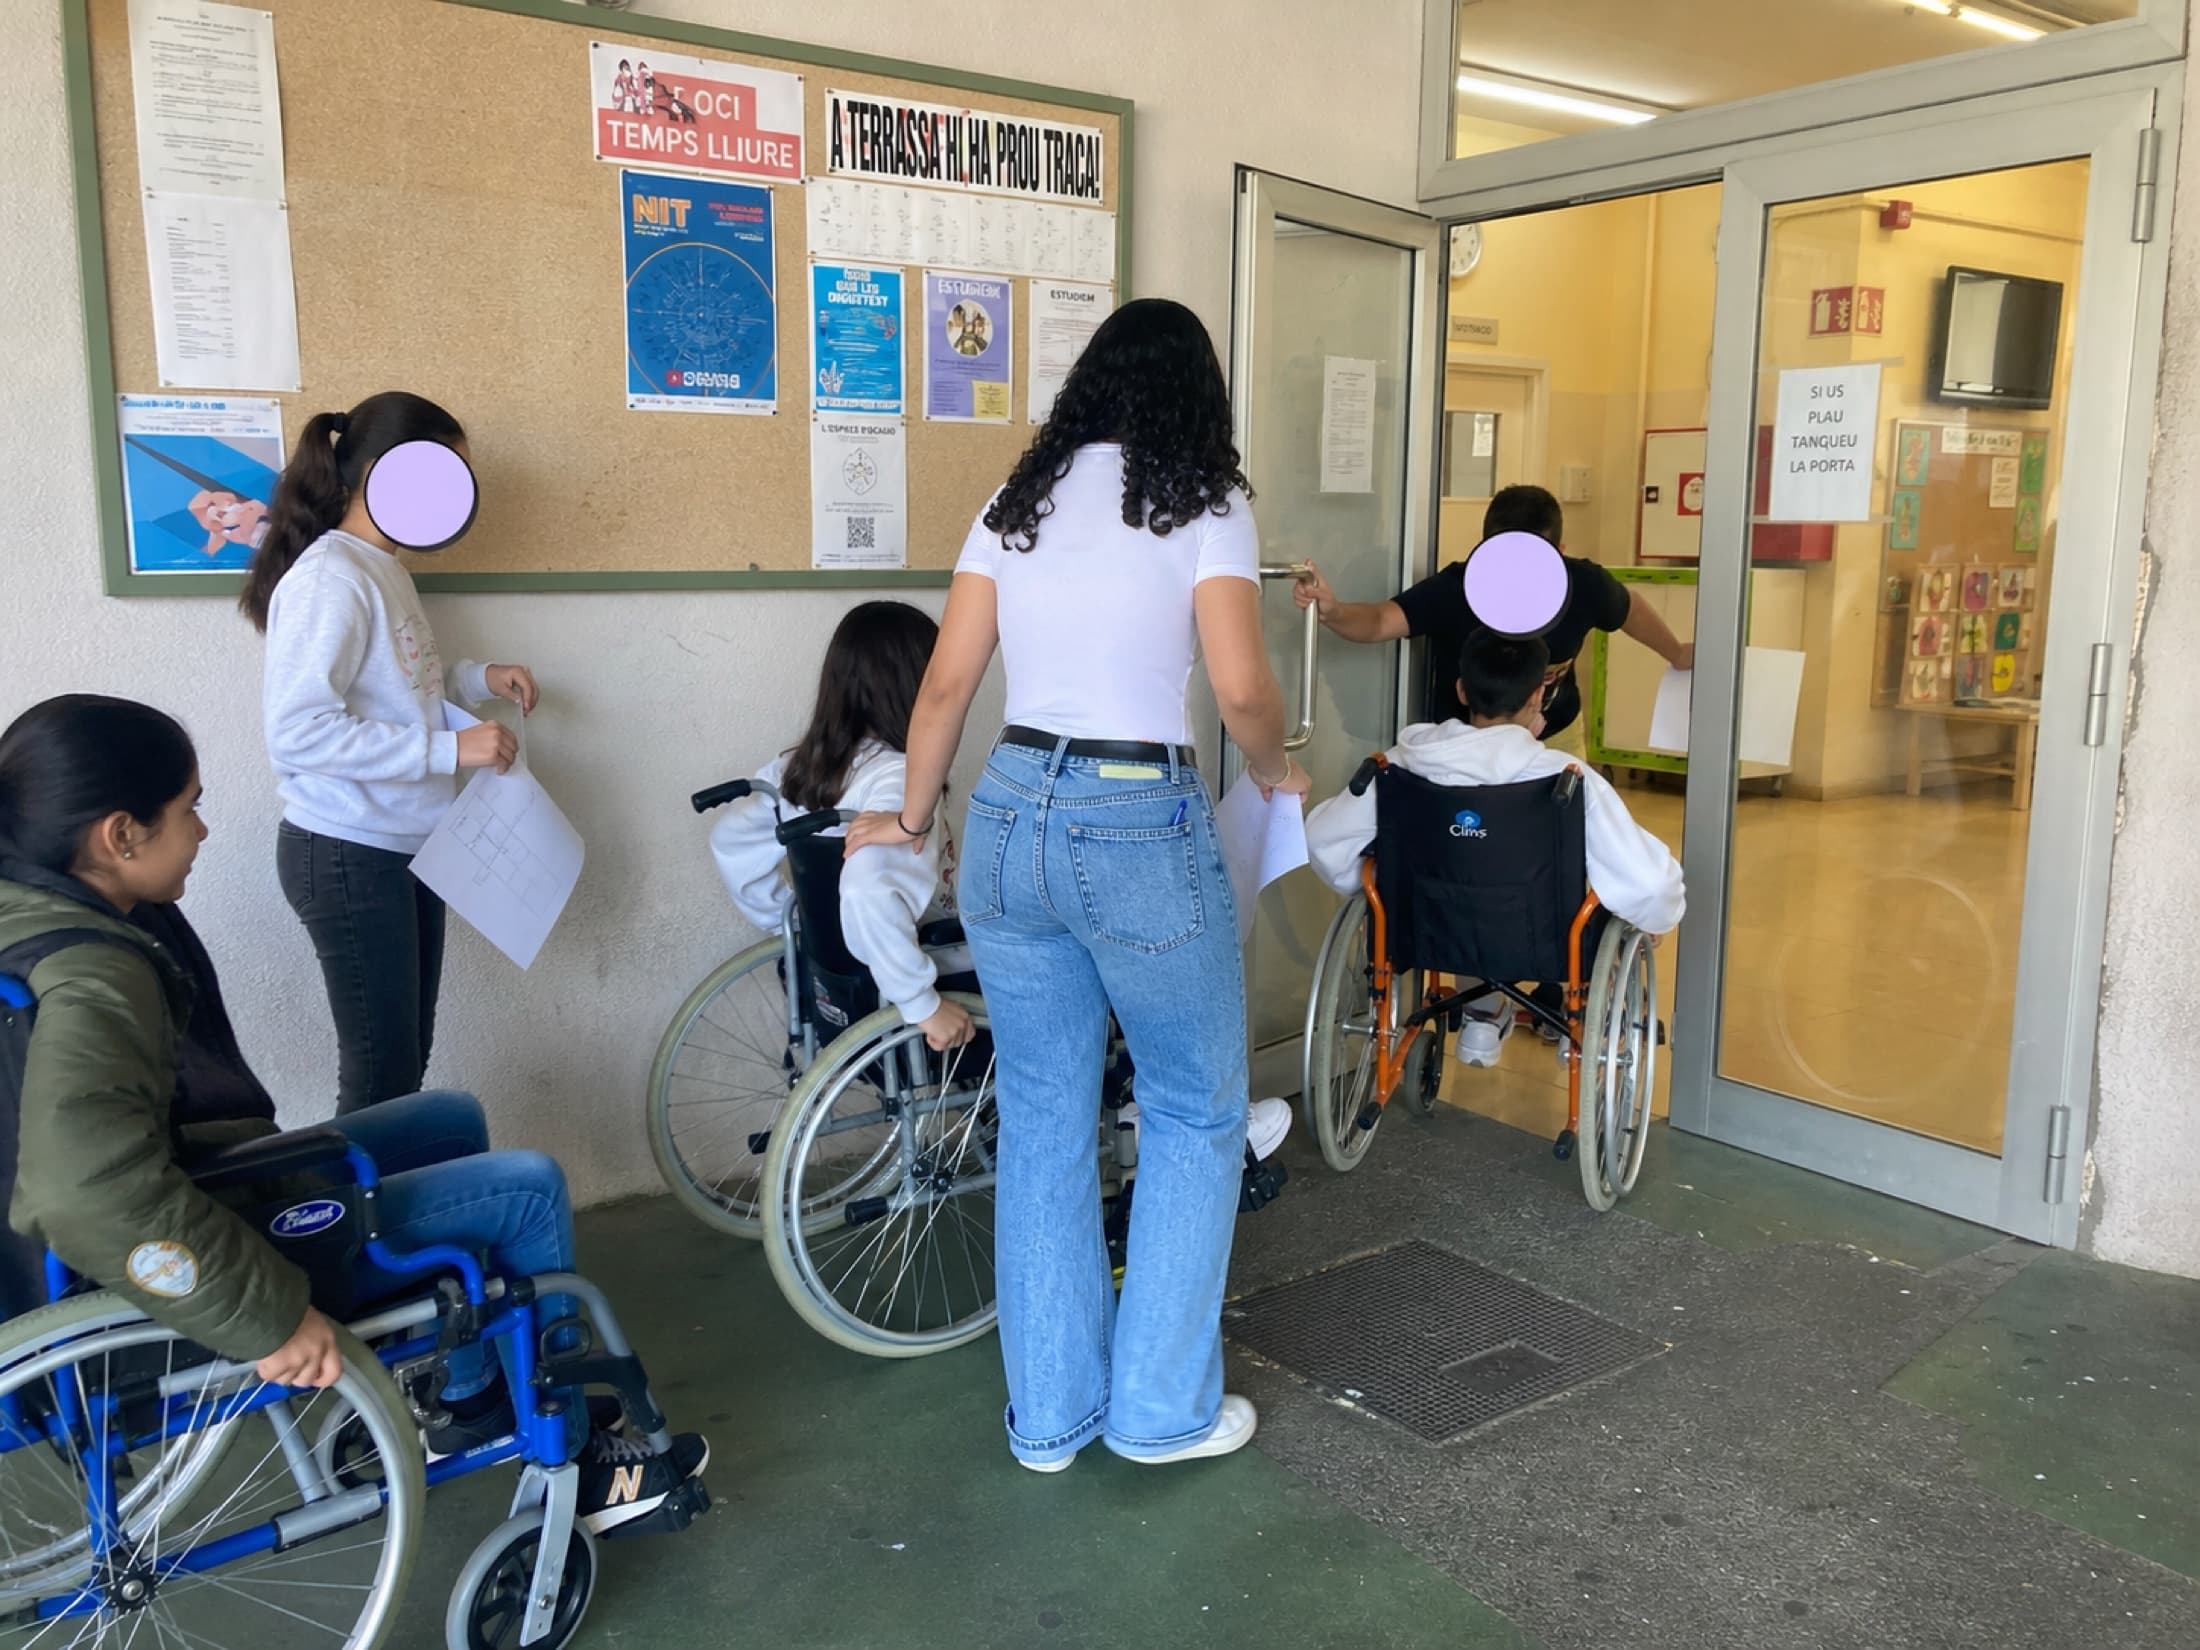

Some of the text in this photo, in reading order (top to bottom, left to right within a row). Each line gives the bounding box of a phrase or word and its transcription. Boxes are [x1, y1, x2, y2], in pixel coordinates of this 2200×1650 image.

[693, 89, 741, 121] OCI
[606, 119, 794, 169] TEMPS LLIURE
[830, 97, 844, 169] A
[846, 99, 942, 180] TERRASSA
[968, 118, 992, 186] HA
[996, 120, 1040, 192] PROU
[631, 192, 692, 228] NIT
[1810, 384, 1844, 399] SI US
[1807, 409, 1844, 425] PLAU
[1790, 458, 1856, 474] LA PORTA
[605, 1463, 645, 1506] N
